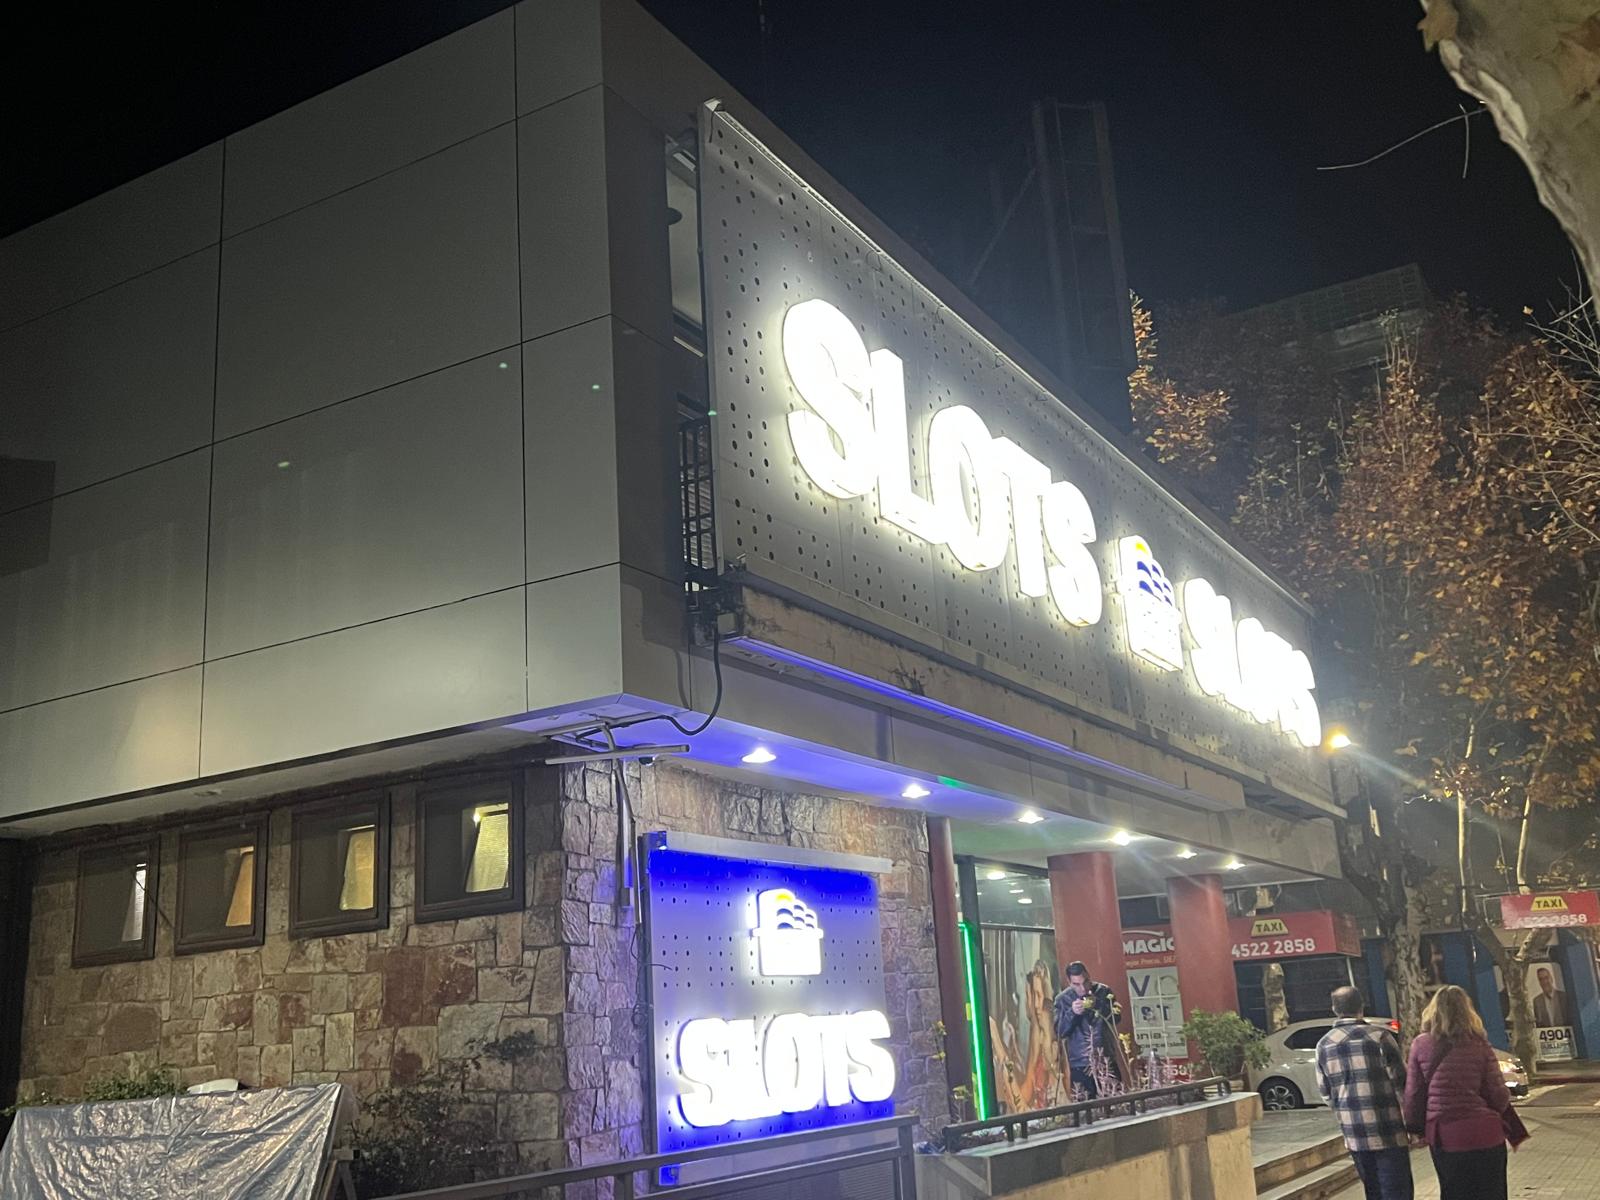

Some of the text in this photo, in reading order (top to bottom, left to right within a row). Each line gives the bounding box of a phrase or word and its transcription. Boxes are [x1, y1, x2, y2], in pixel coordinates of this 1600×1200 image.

[782, 298, 1102, 627] SLOTS
[1535, 899, 1562, 909] TAXI
[1255, 922, 1283, 933] TAXI
[1231, 938, 1316, 957] 4522 2858
[1540, 1028, 1572, 1042] 4904
[677, 1009, 896, 1128] SLOTS
